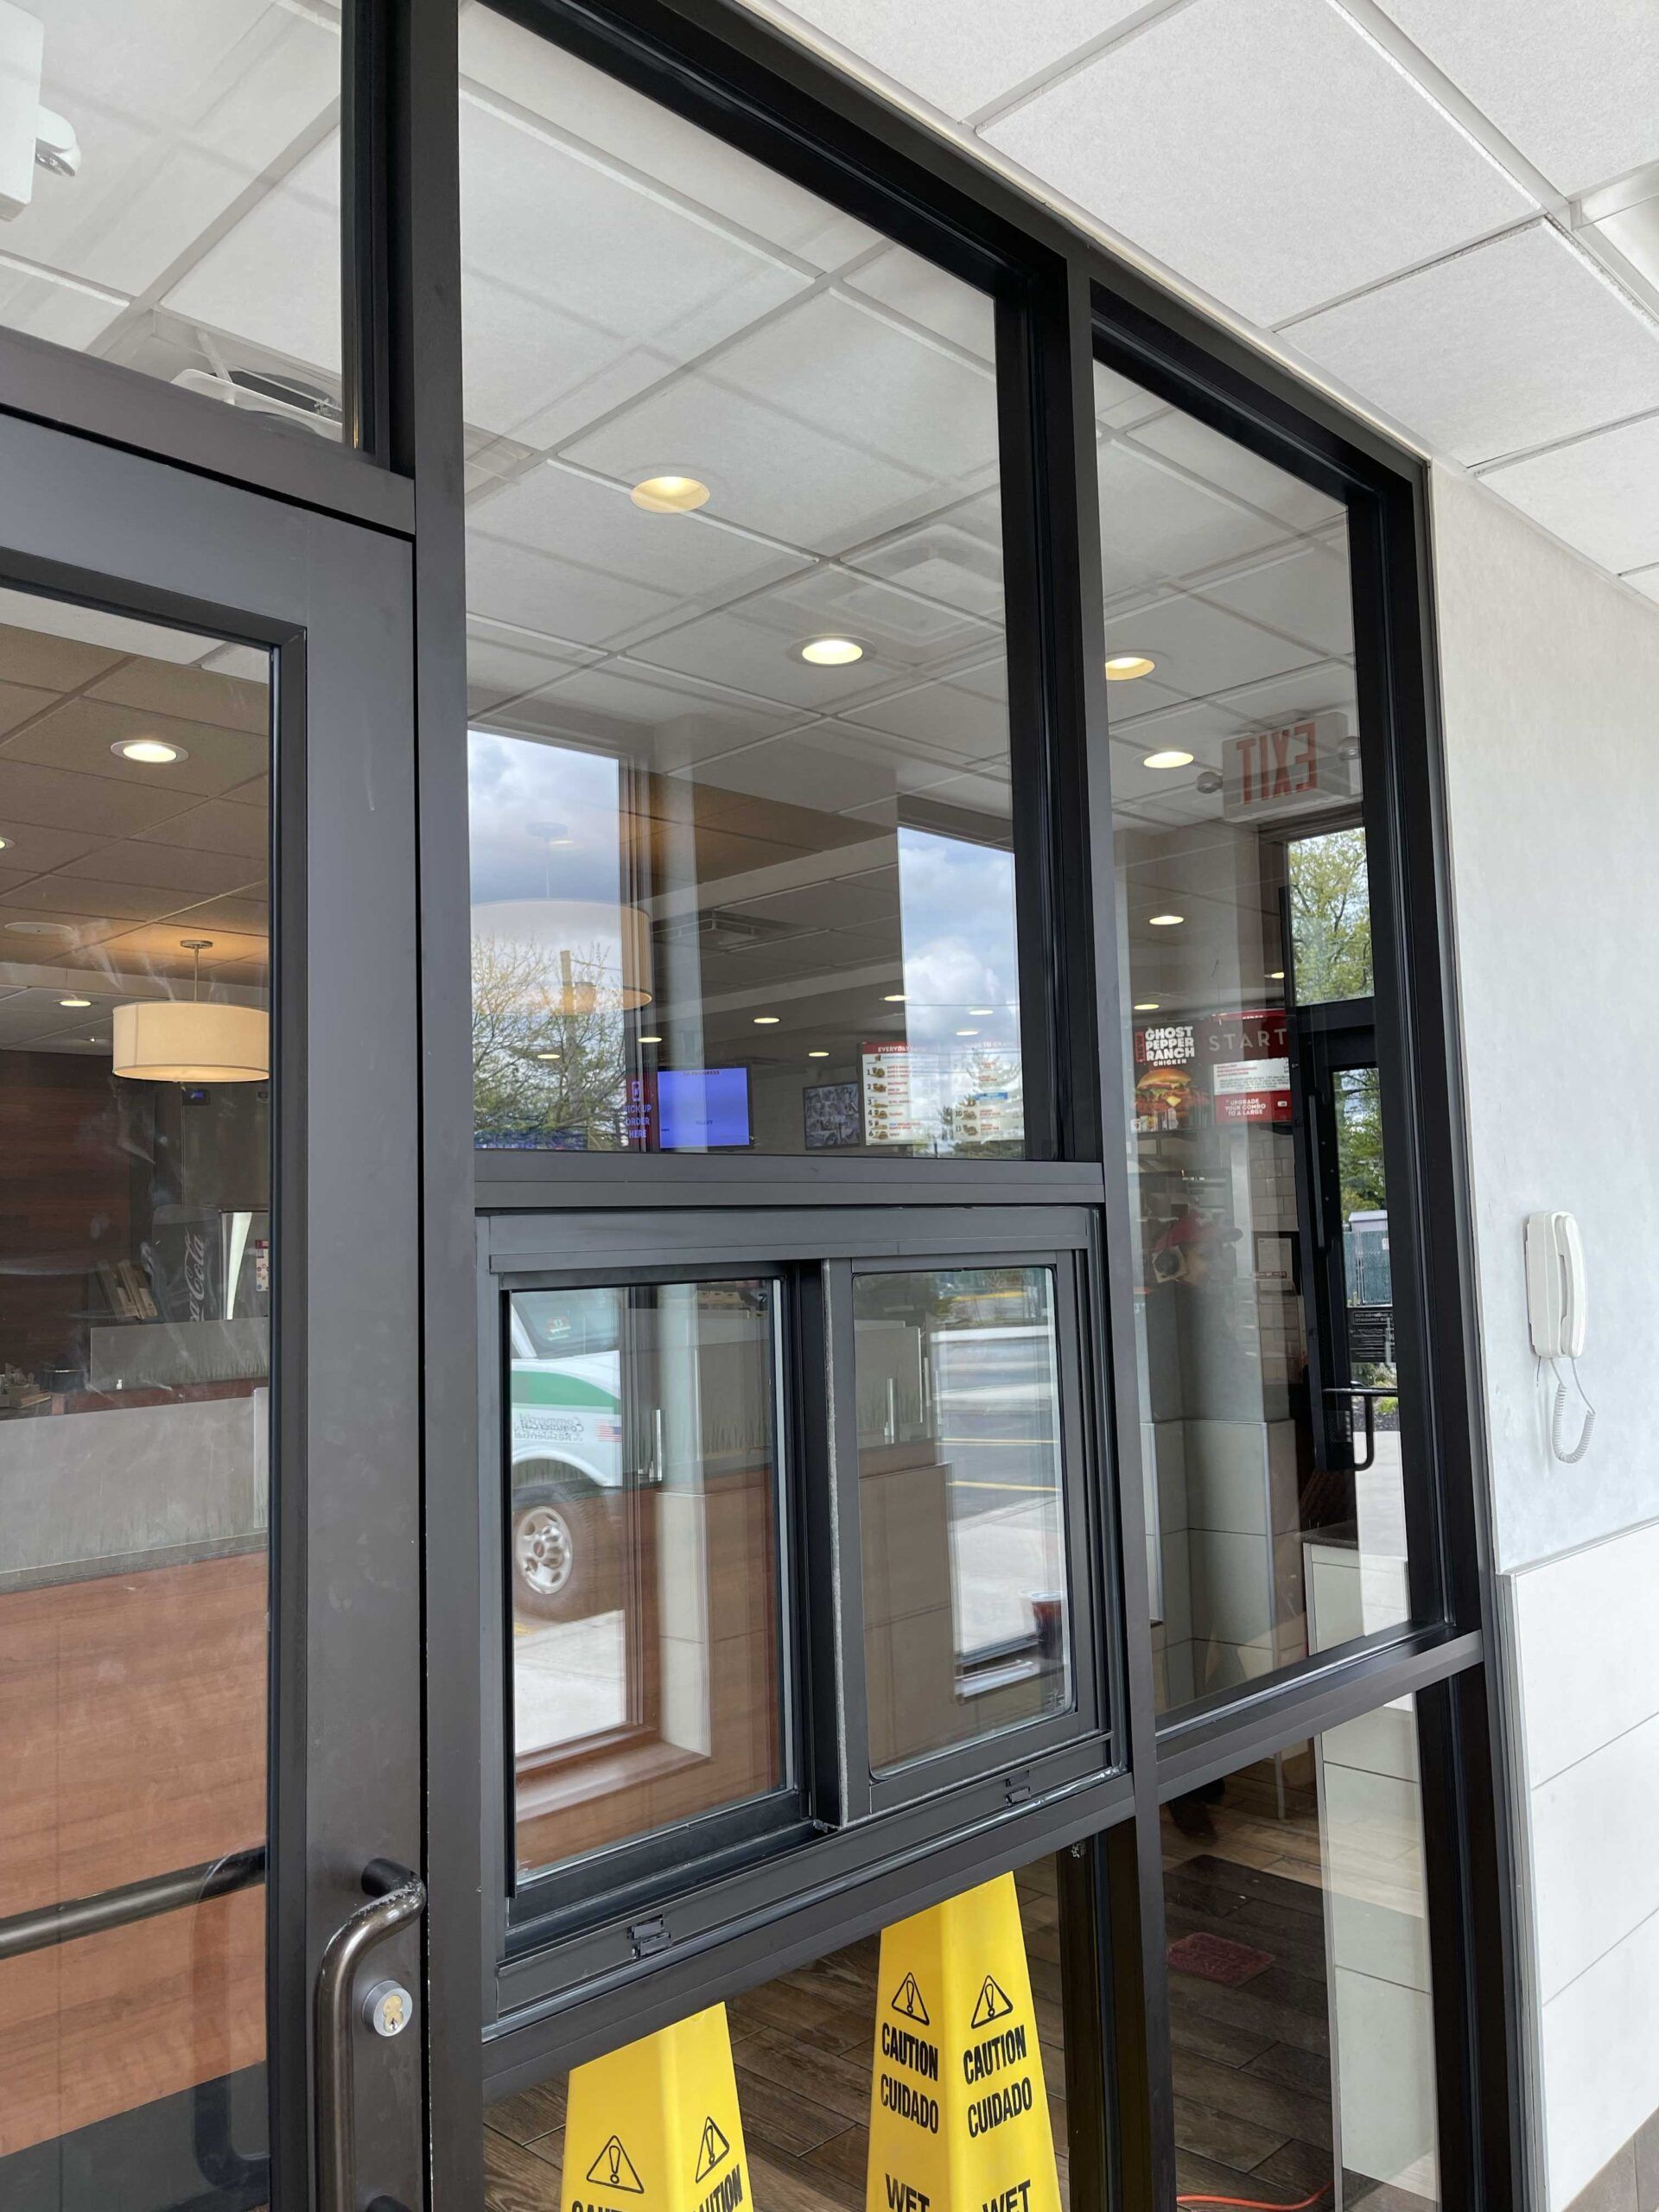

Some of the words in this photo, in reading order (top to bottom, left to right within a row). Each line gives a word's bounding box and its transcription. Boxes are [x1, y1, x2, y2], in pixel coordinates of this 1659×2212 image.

[1145, 1026, 1193, 1040] GHOST
[1145, 1037, 1194, 1051] PEPPER
[1146, 1047, 1195, 1061] RANCH
[1209, 1028, 1287, 1052] START
[882, 2022, 938, 2082] CAUTION
[963, 2024, 1027, 2085] CAUTION
[880, 2074, 939, 2134] CUIDADO
[967, 2076, 1033, 2139] CUIDADO
